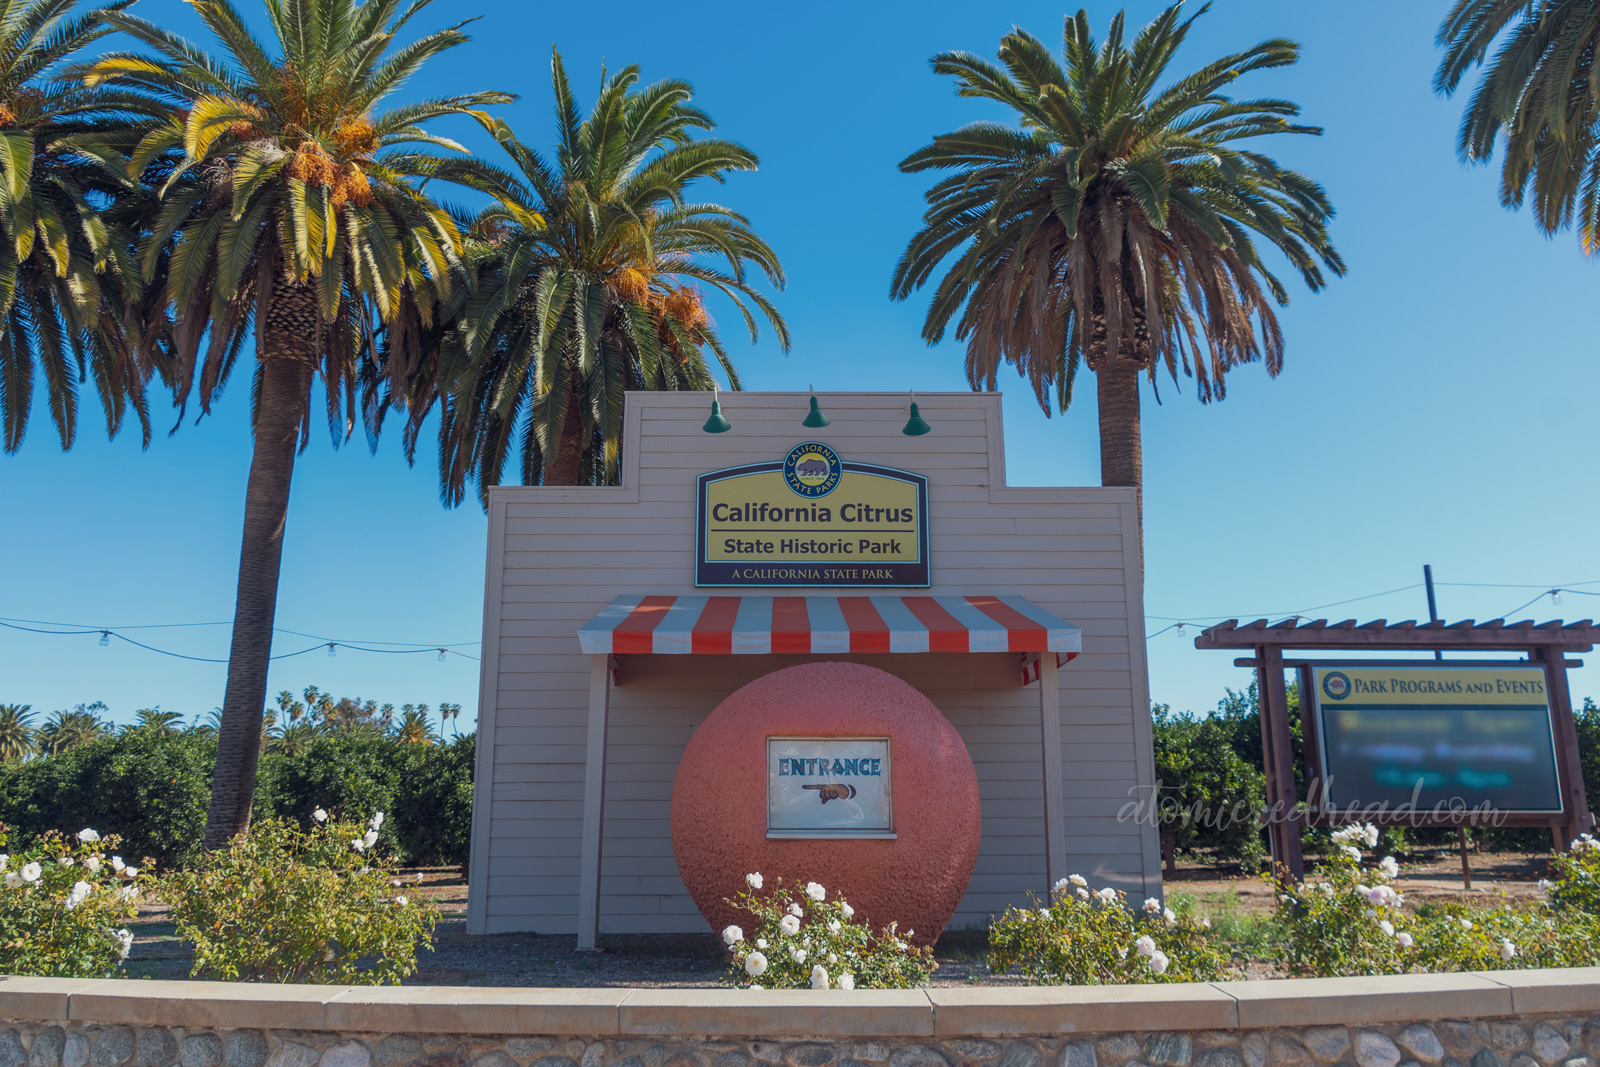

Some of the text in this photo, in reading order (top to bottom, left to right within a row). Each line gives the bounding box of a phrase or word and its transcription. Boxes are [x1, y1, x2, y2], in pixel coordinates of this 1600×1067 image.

[788, 445, 837, 467] CALIFORNIA
[787, 472, 838, 494] STATE PARKS
[712, 503, 914, 523] California Citrus
[723, 538, 902, 554] State Historic Park
[732, 569, 894, 579] A CALIFORNIA STATE PARK
[1354, 678, 1388, 694] PARK
[1390, 678, 1463, 694] PROGRAMS
[1496, 679, 1544, 694] EVENTS
[778, 757, 881, 777] ENTRANCE
